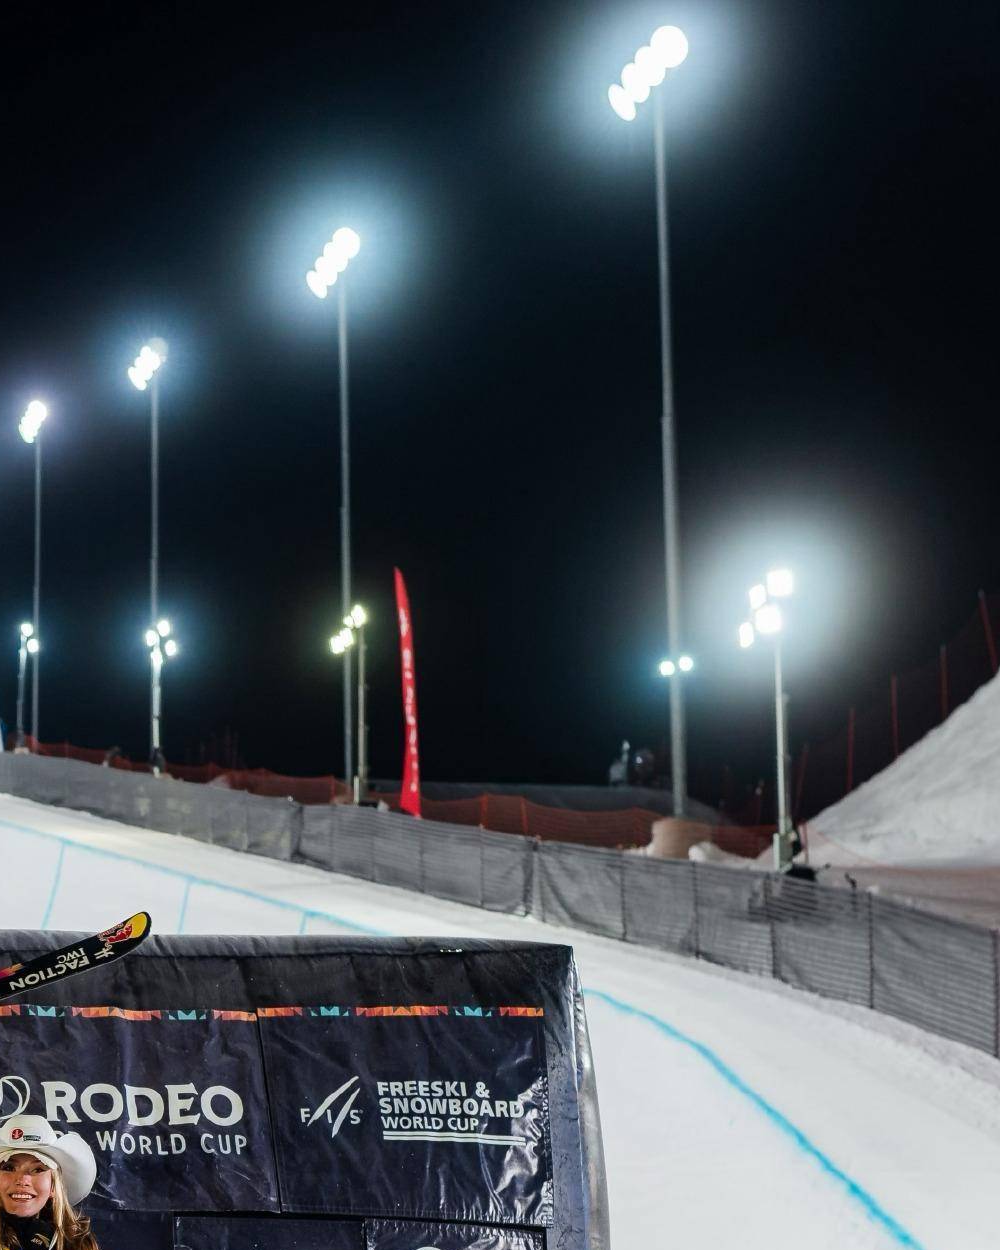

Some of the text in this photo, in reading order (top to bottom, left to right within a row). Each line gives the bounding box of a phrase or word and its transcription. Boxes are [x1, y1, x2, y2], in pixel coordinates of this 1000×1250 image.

[9, 955, 90, 991] FACTION
[377, 1081, 490, 1098] FREESKI &
[41, 1081, 243, 1127] RODEO
[380, 1097, 524, 1119] SNOWBOARD
[381, 1115, 479, 1131] WORLD CUP
[96, 1130, 187, 1156] WORLD
[200, 1133, 248, 1155] CUP
